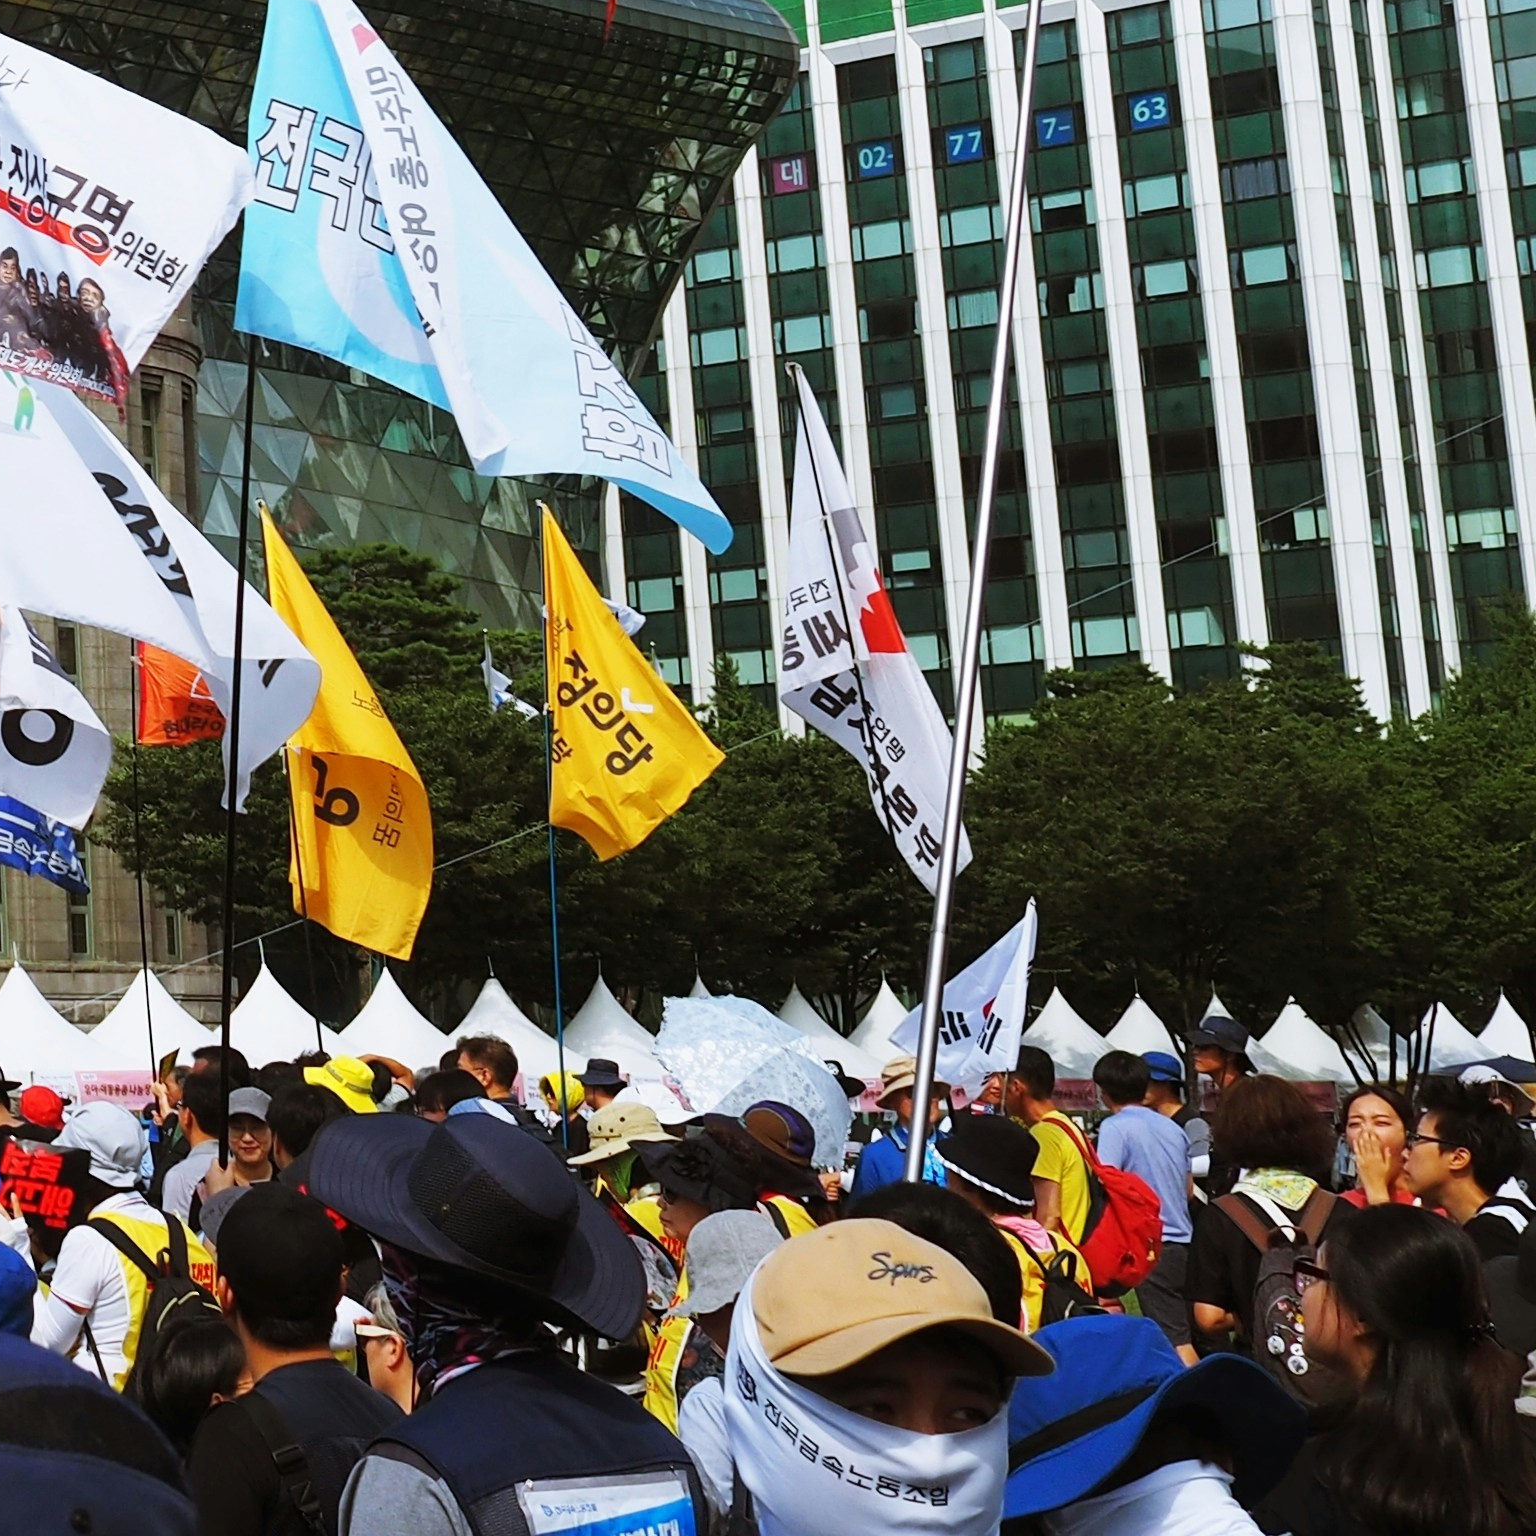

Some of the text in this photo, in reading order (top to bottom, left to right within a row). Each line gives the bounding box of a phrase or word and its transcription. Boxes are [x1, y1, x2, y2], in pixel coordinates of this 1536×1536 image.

[1131, 95, 1169, 125] 63
[6, 142, 136, 256] 진상규명
[111, 229, 190, 294] 위원회
[556, 648, 654, 776] 정의당
[867, 1250, 938, 1287] Spurs
[764, 1397, 951, 1508] 전국금속노동조합
